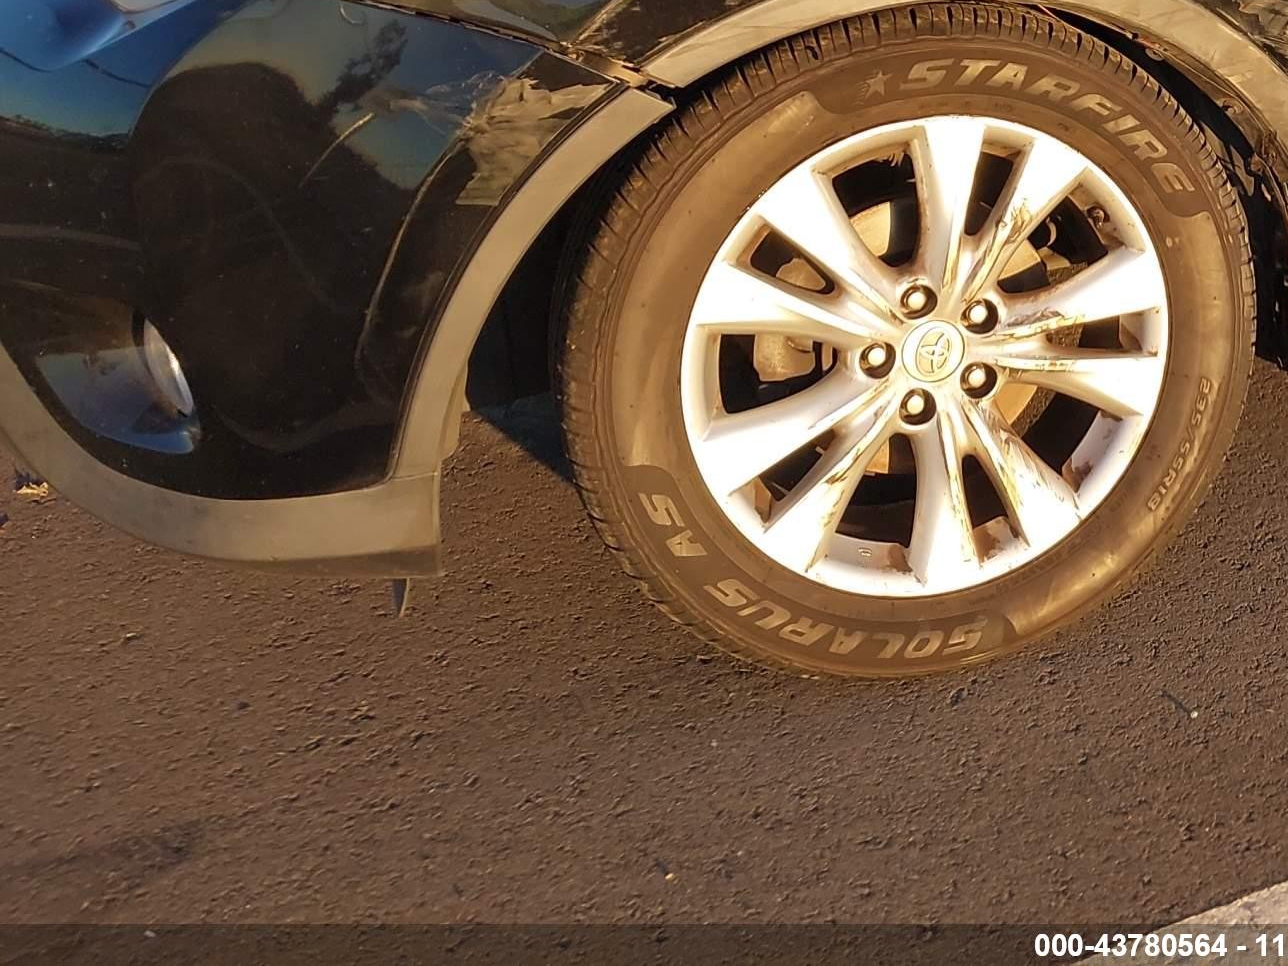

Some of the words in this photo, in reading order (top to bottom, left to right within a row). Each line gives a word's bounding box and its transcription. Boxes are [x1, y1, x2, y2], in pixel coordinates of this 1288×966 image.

[906, 58, 1196, 194] STARFIRE
[1147, 377, 1211, 512] 235/55R18
[638, 492, 707, 558] AS
[703, 578, 987, 659] SOLARUS
